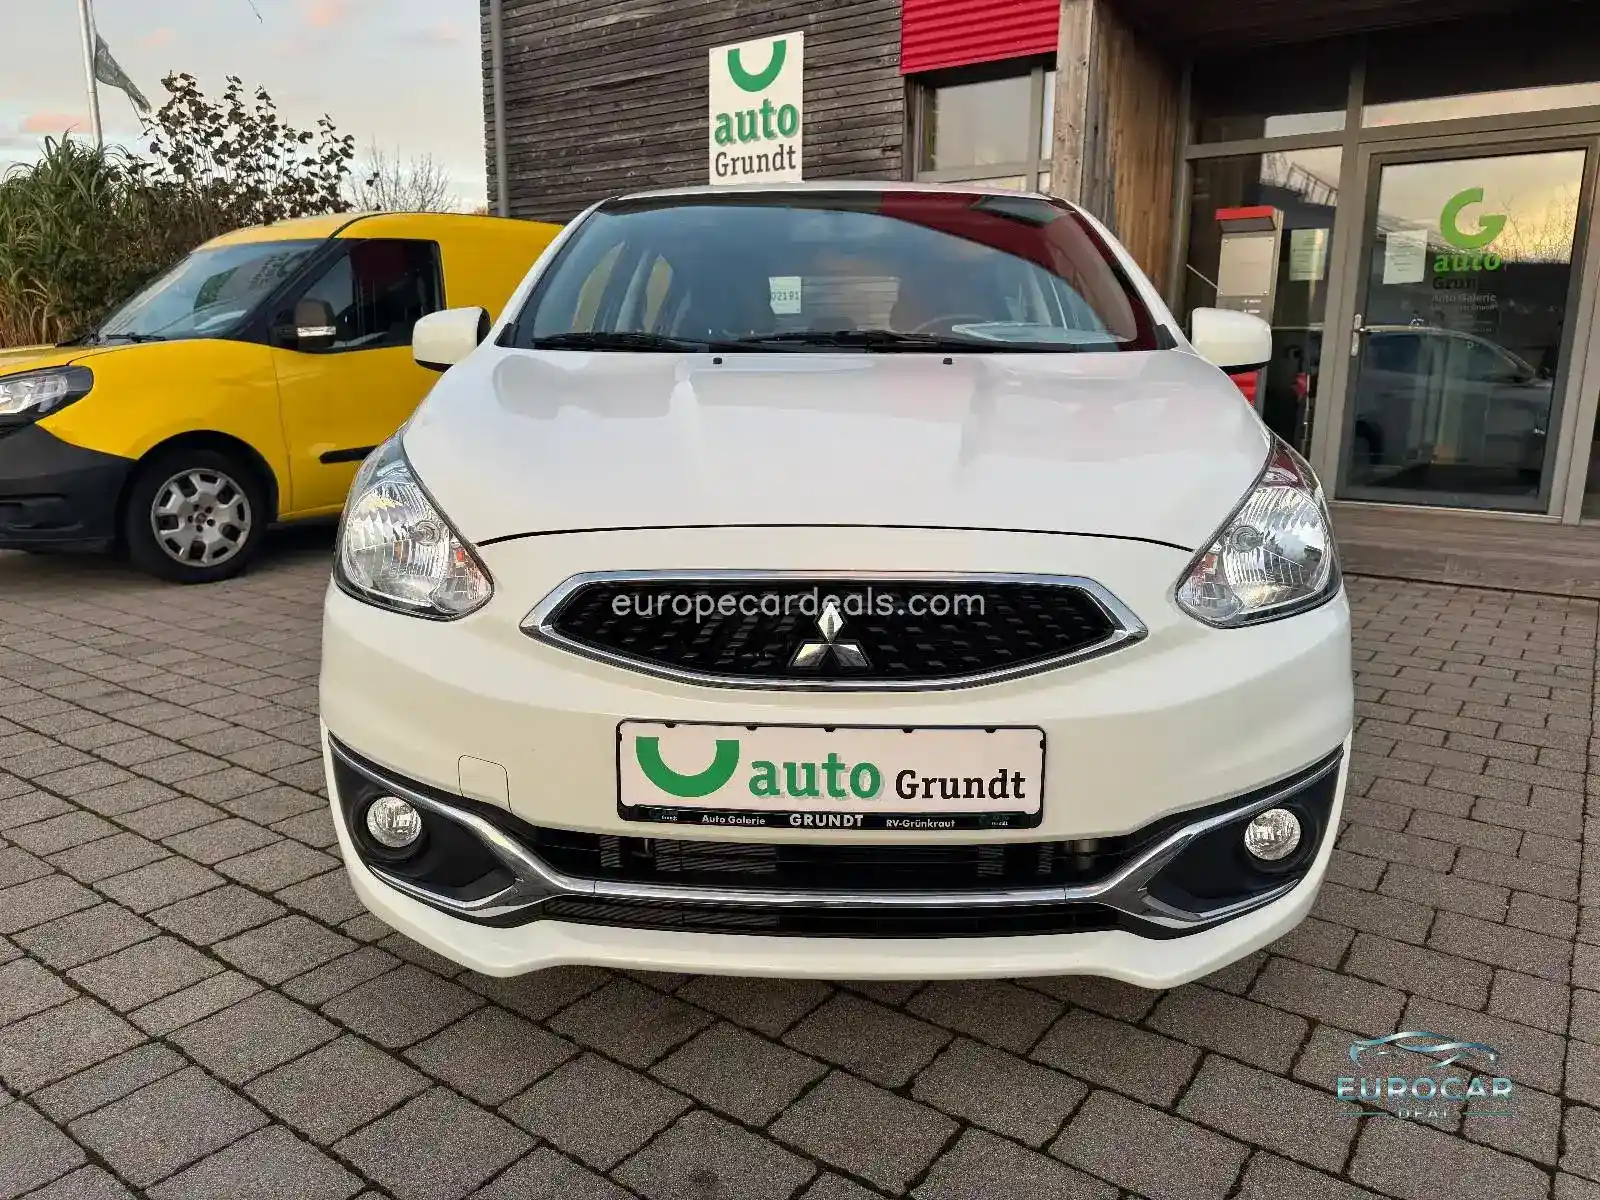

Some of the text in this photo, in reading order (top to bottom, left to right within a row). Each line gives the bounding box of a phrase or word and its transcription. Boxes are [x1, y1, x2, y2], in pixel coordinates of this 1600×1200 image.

[714, 98, 799, 146] auto
[715, 144, 797, 178] Grundt
[1433, 251, 1501, 273] auto
[748, 752, 1026, 800] auto Grundt
[701, 813, 956, 829] Auto Galerie GRUNDT RV-Grünkraut
